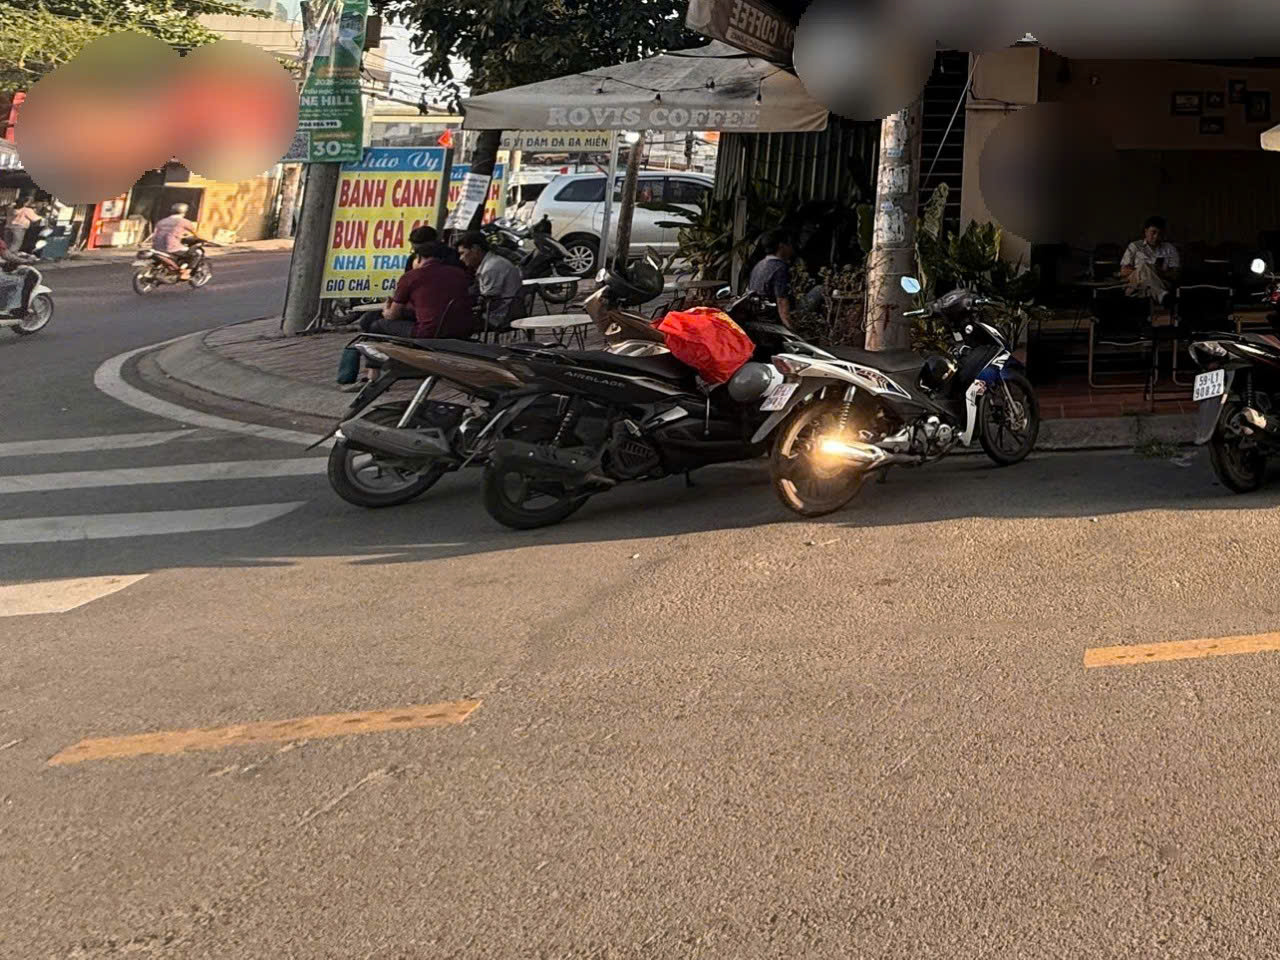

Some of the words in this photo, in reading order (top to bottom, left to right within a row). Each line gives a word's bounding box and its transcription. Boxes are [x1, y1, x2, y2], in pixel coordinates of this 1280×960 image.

[321, 95, 353, 106] HILL
[546, 106, 641, 128] ROVIS
[650, 107, 760, 129] COFFEE
[313, 140, 341, 156] 30
[407, 150, 440, 171] Vy
[391, 179, 438, 208] CANH
[373, 212, 405, 250] CHẢ
[333, 255, 366, 270] NHA
